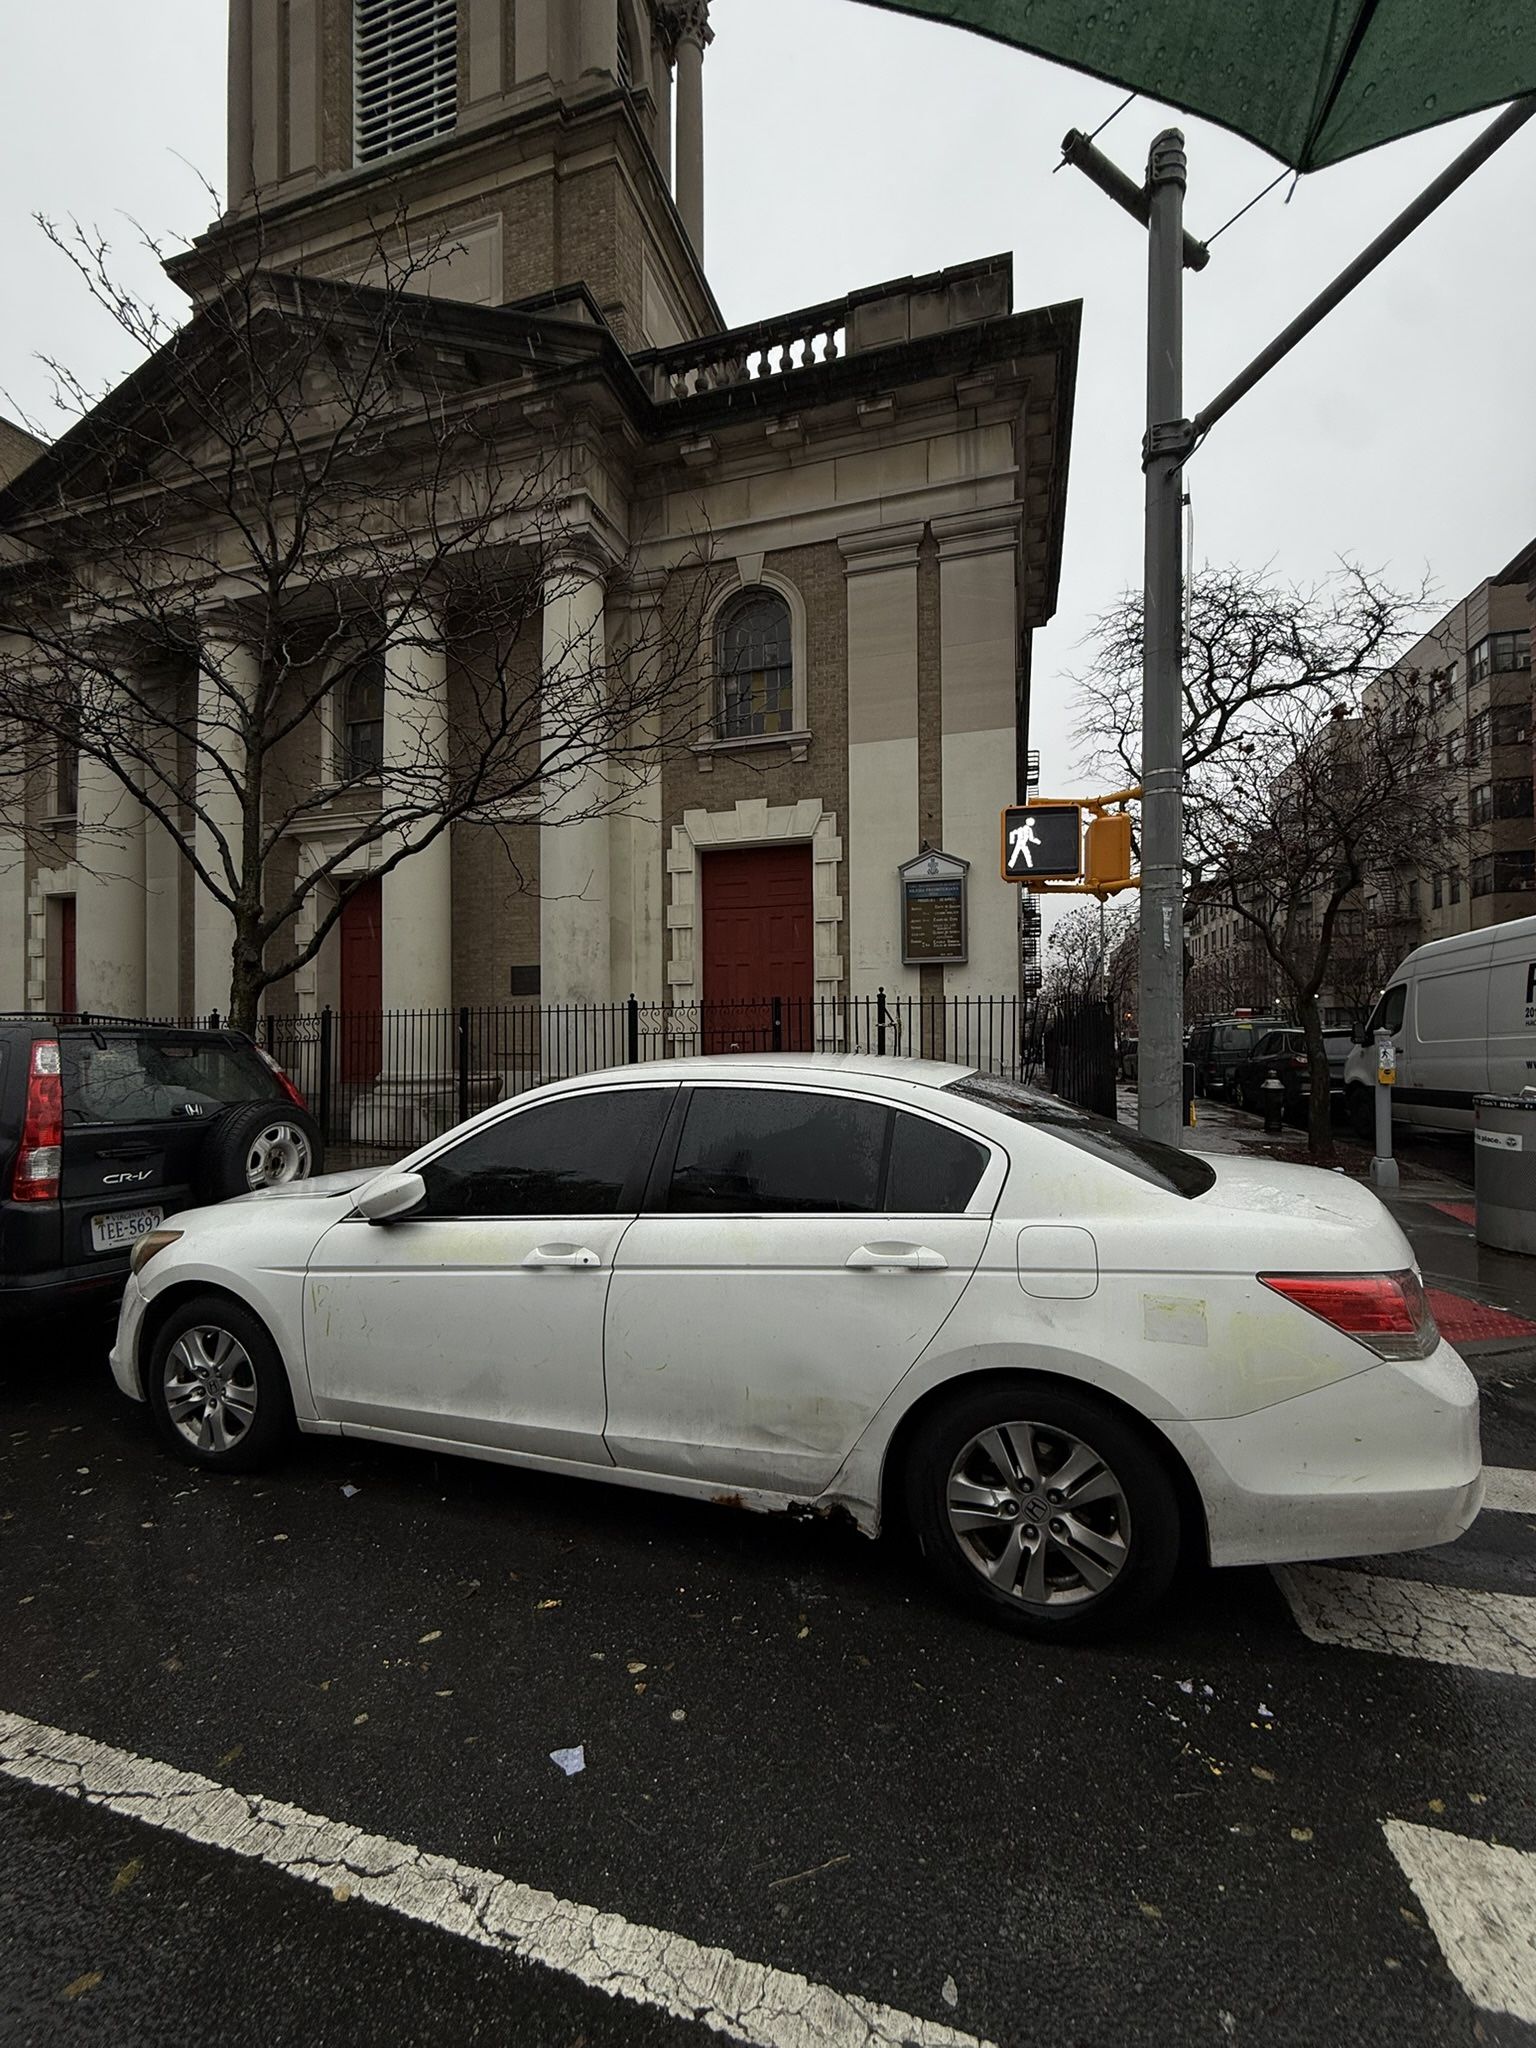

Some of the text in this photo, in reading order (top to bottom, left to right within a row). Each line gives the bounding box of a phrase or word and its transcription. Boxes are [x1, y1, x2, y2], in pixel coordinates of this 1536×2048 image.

[1525, 1007, 1536, 1018] 20
[102, 1169, 153, 1184] CR-V
[111, 1210, 146, 1221] VIRGINIA
